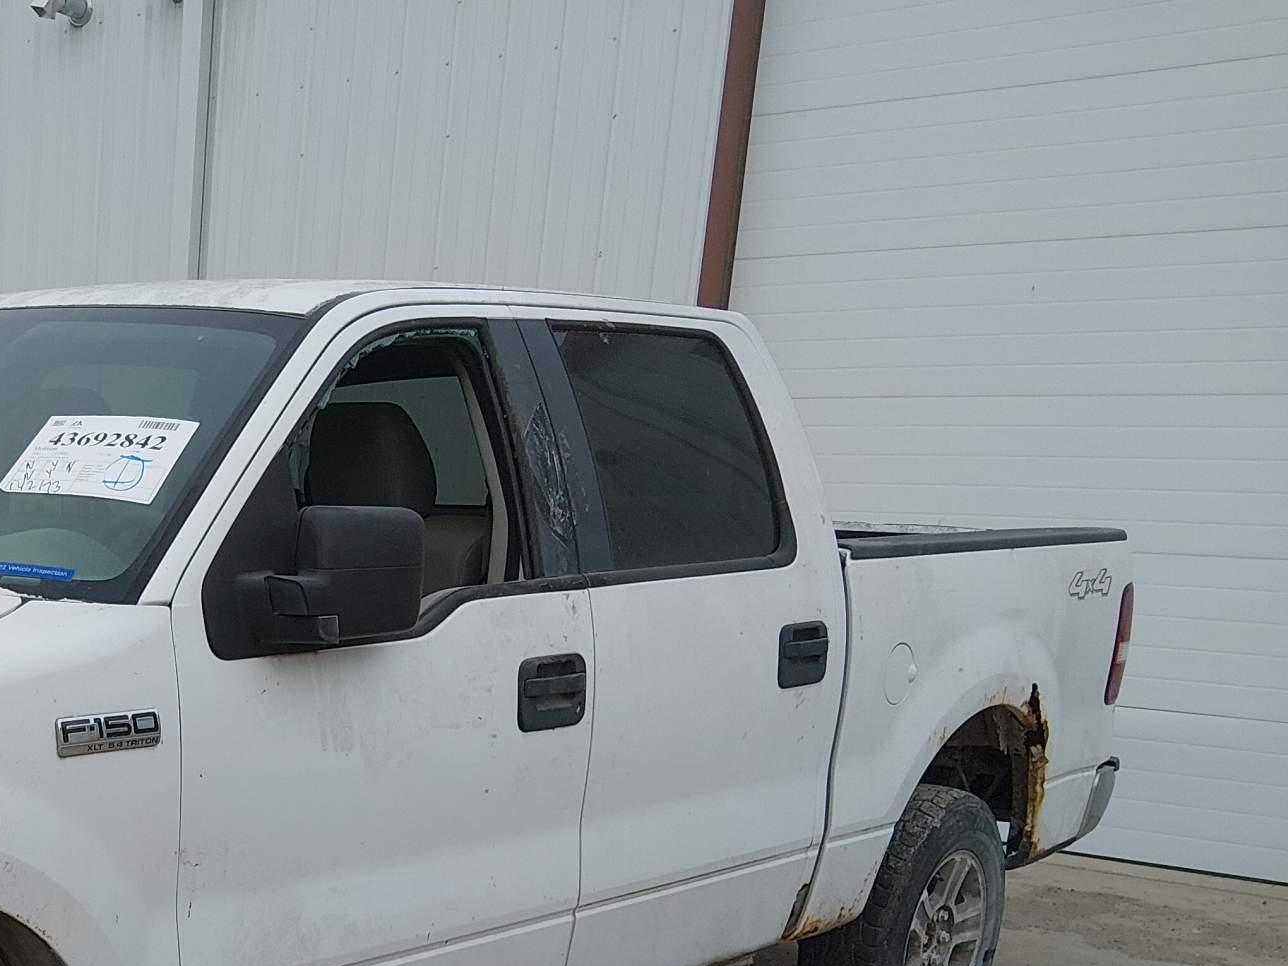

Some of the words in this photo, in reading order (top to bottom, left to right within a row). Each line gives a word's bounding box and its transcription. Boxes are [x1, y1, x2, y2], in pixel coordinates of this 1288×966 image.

[48, 431, 167, 451] 43692842
[8, 565, 32, 573] Vehicle
[32, 567, 68, 577] Inspection
[1068, 568, 1112, 600] 4x4
[87, 743, 104, 752] XLT
[126, 737, 159, 747] TRITON
